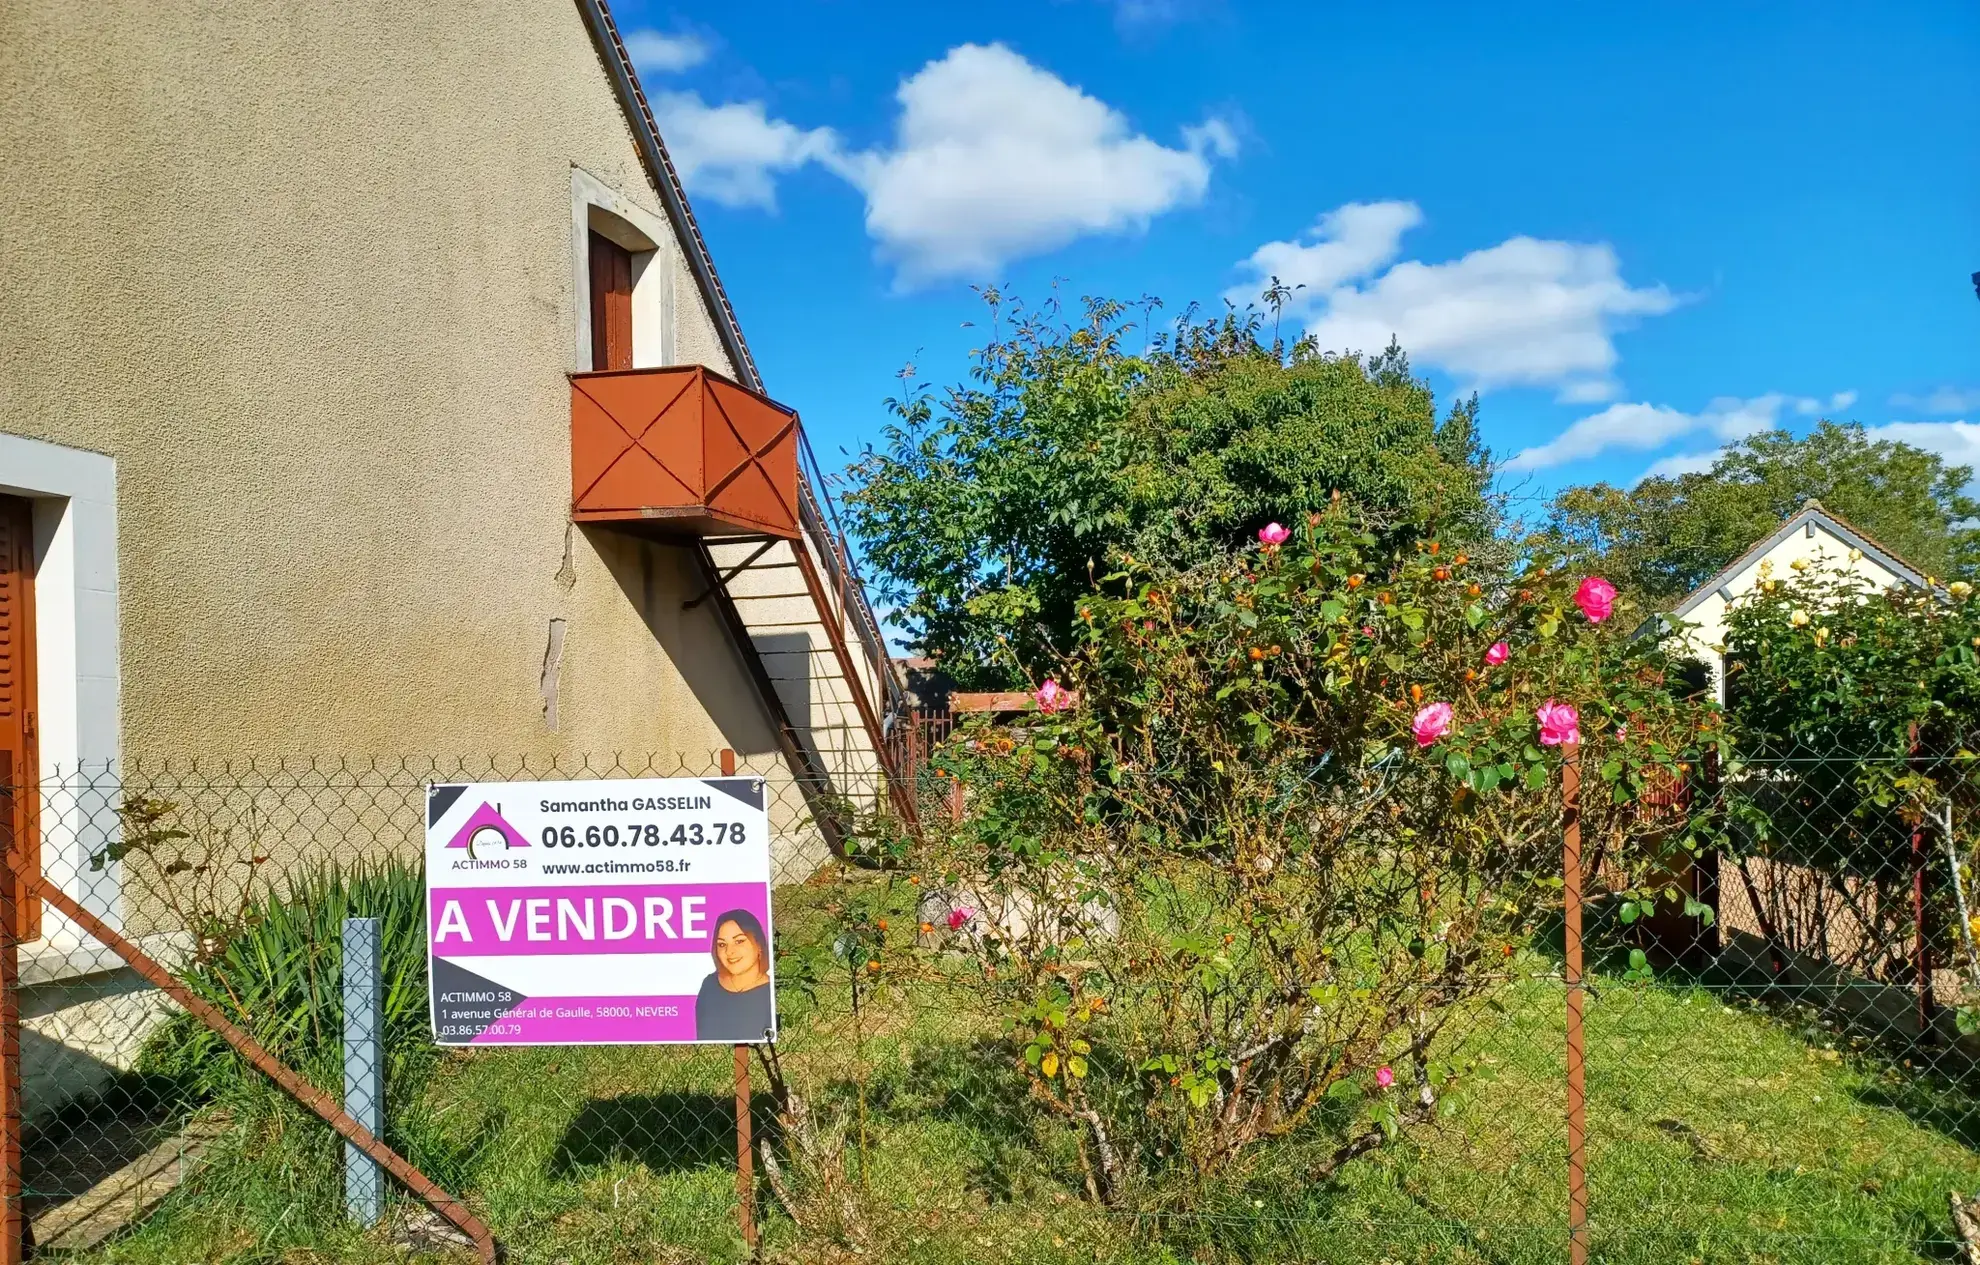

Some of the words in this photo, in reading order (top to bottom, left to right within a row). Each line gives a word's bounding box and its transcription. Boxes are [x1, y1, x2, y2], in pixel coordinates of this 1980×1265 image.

[540, 798, 628, 813] Samantha
[632, 796, 711, 811] GASSELIN
[541, 822, 746, 848] 06.60.78.43.78
[451, 860, 510, 870] ACTIMMO
[513, 859, 527, 869] 58
[542, 859, 691, 875] www.actimmo58.fr
[434, 900, 473, 943] A
[486, 896, 708, 941] VENDRE
[440, 992, 495, 1003] ACTIMMO
[498, 991, 511, 1002] 58
[442, 1009, 447, 1019] 1
[451, 1010, 491, 1019] avenue
[494, 1008, 536, 1018] Général
[539, 1008, 553, 1018] de
[556, 1007, 593, 1018] Gaulle,
[596, 1007, 632, 1018] 58000,
[635, 1006, 679, 1017] NEVERS
[442, 1024, 521, 1035] 03.86.57.00.79
